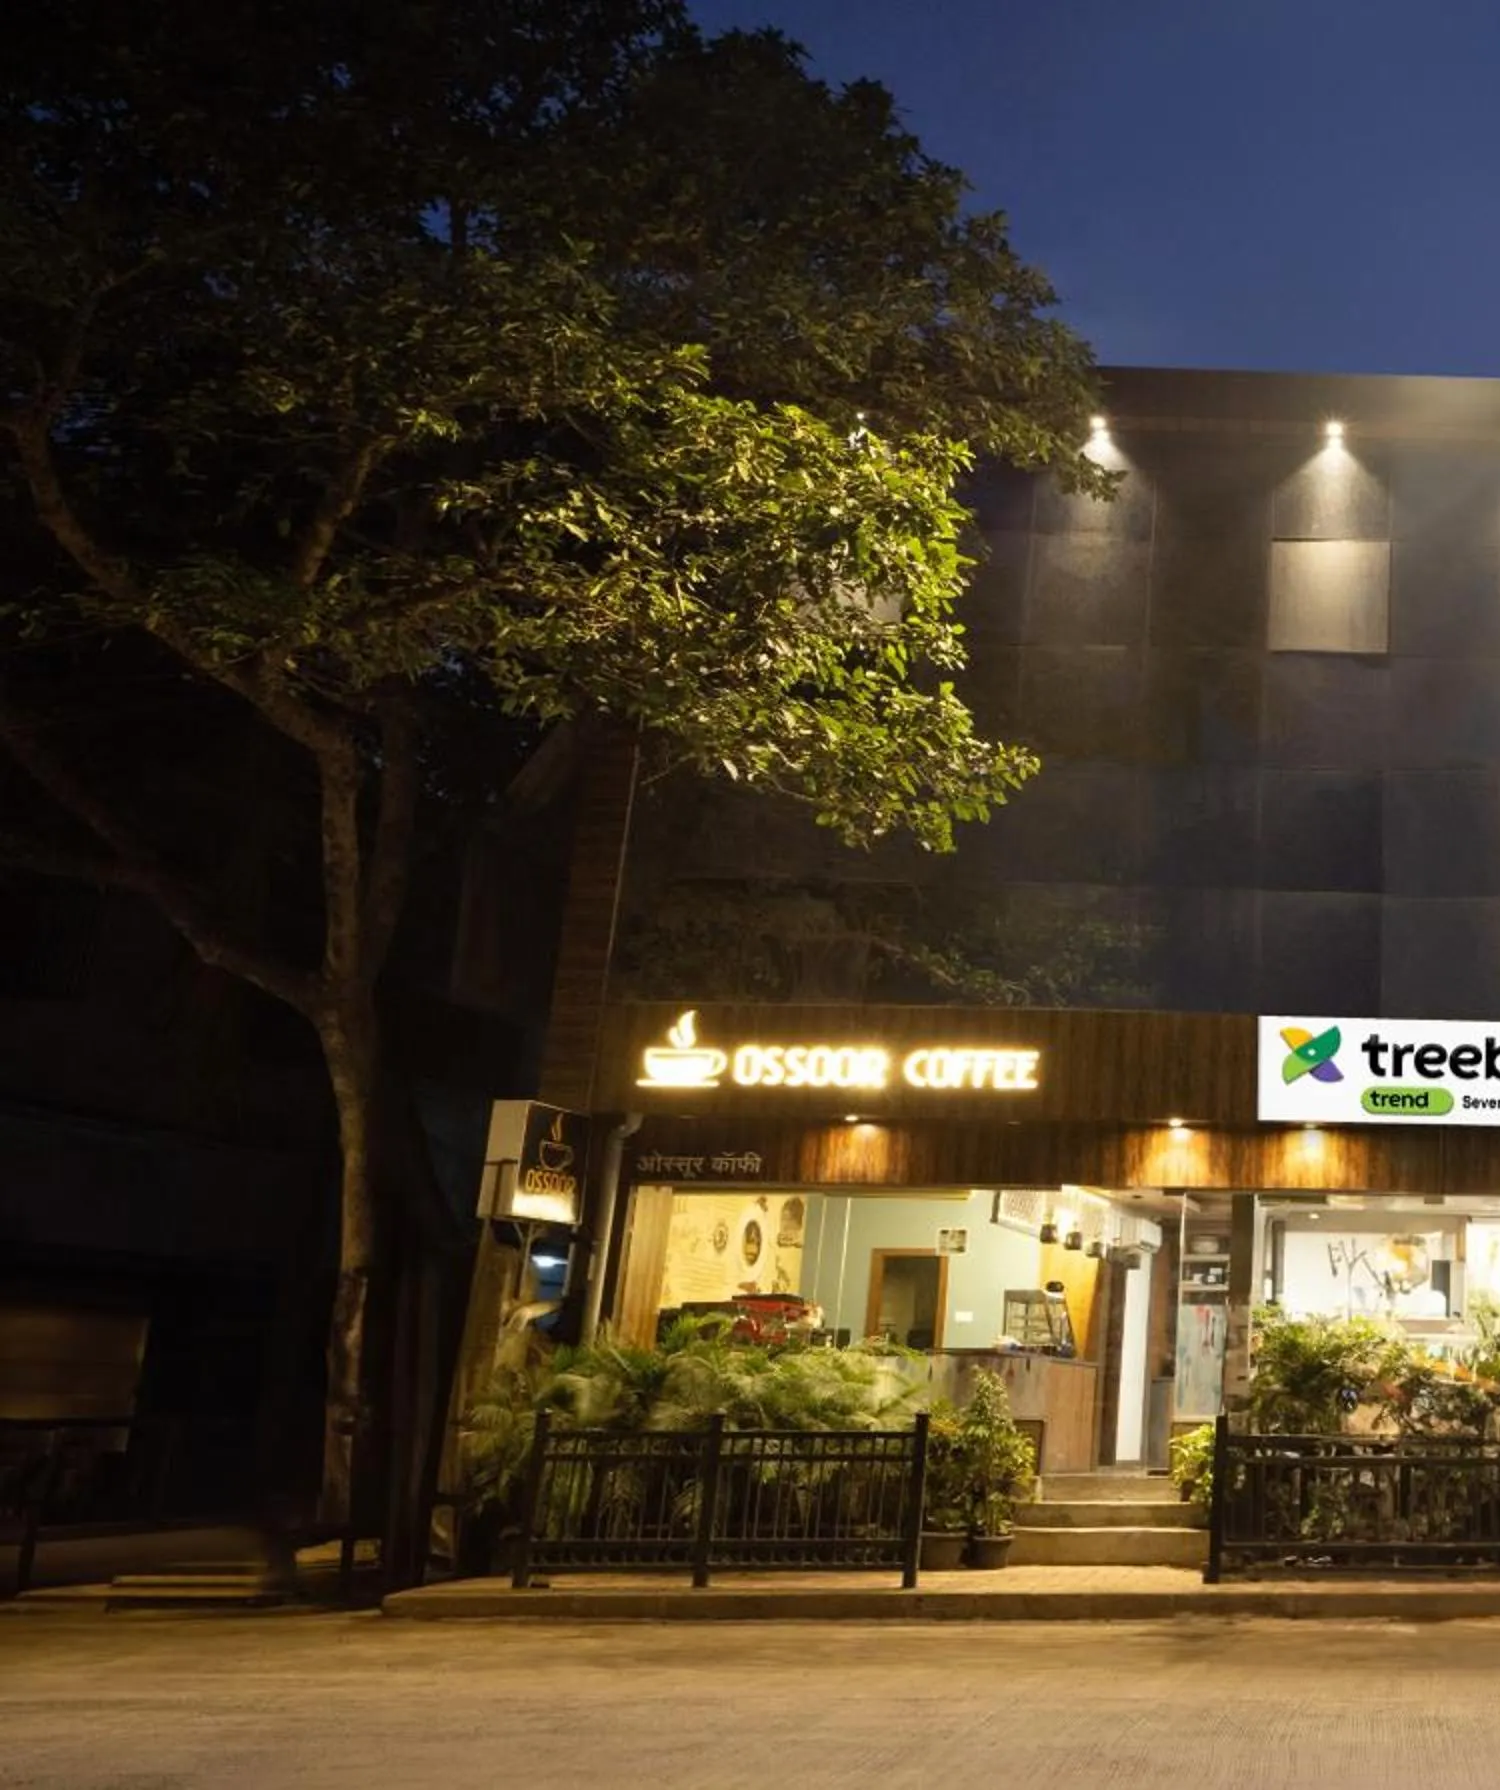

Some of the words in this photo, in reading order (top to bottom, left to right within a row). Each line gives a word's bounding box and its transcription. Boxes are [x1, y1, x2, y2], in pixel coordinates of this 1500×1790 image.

[732, 1045, 888, 1088] OSSOOR
[904, 1048, 1040, 1089] COFFEE
[1370, 1089, 1430, 1107] trend
